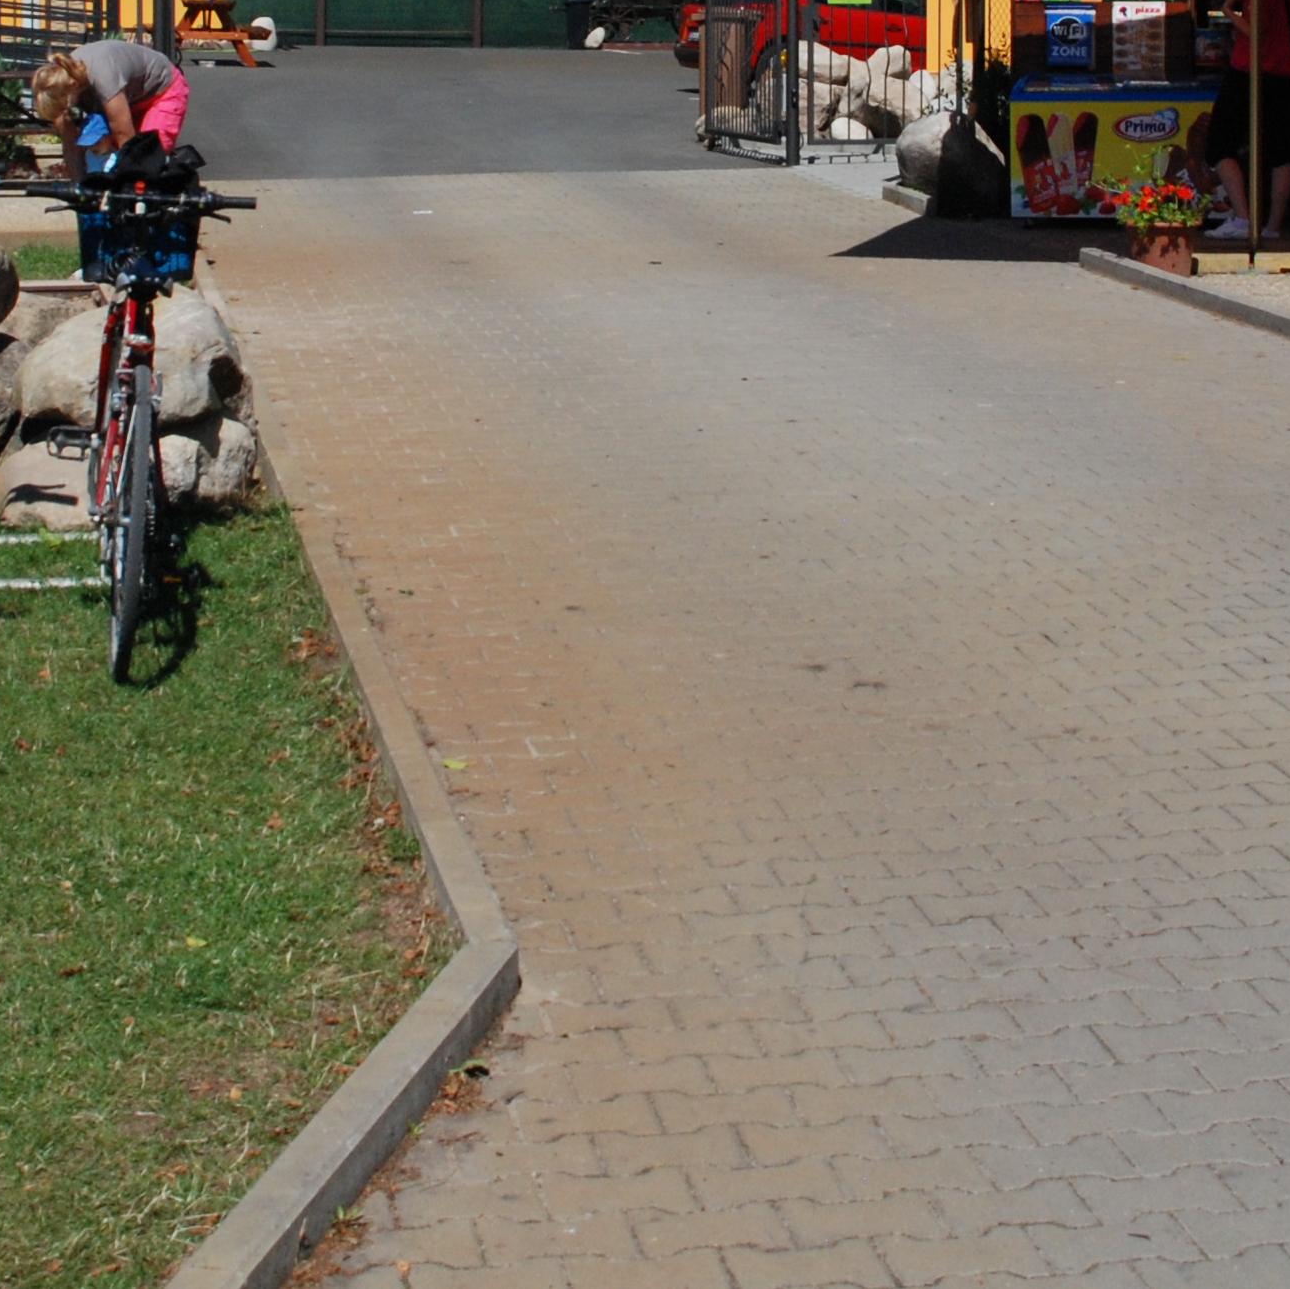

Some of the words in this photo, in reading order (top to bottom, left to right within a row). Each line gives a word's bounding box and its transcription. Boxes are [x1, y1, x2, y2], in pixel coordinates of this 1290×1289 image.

[1135, 6, 1161, 14] pizza
[1051, 46, 1087, 57] ZONE
[1124, 120, 1167, 133] Prima
